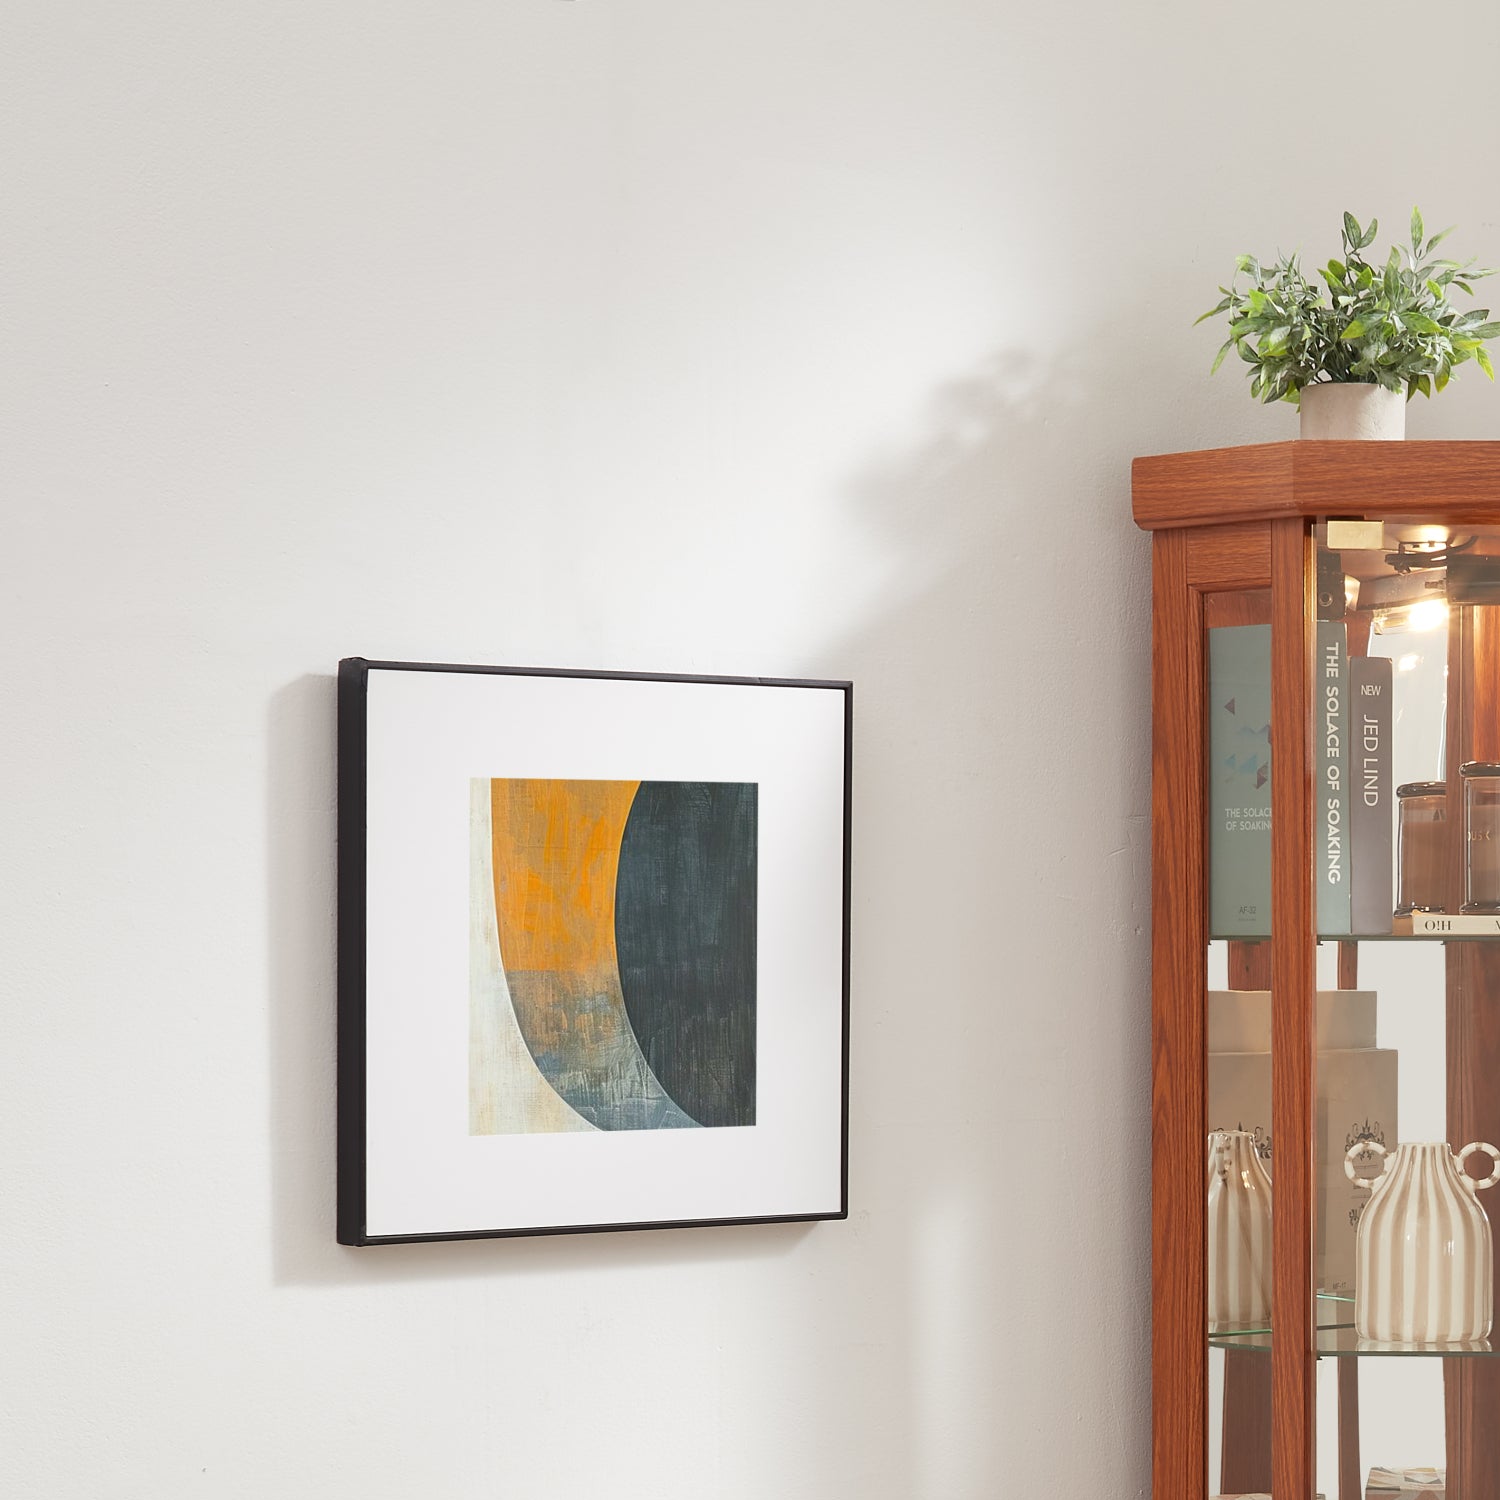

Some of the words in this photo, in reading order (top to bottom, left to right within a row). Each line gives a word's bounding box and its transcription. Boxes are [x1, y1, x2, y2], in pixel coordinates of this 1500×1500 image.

[1326, 641, 1339, 678] THE
[1361, 685, 1381, 696] NEW
[1326, 686, 1340, 758] SOLACE
[1364, 714, 1378, 752] JED
[1327, 765, 1340, 790] OF
[1363, 758, 1379, 807] LIND
[1225, 807, 1240, 818] THE
[1226, 821, 1237, 831] OF
[1327, 798, 1341, 884] SOAKING
[1424, 920, 1452, 930] O!H
